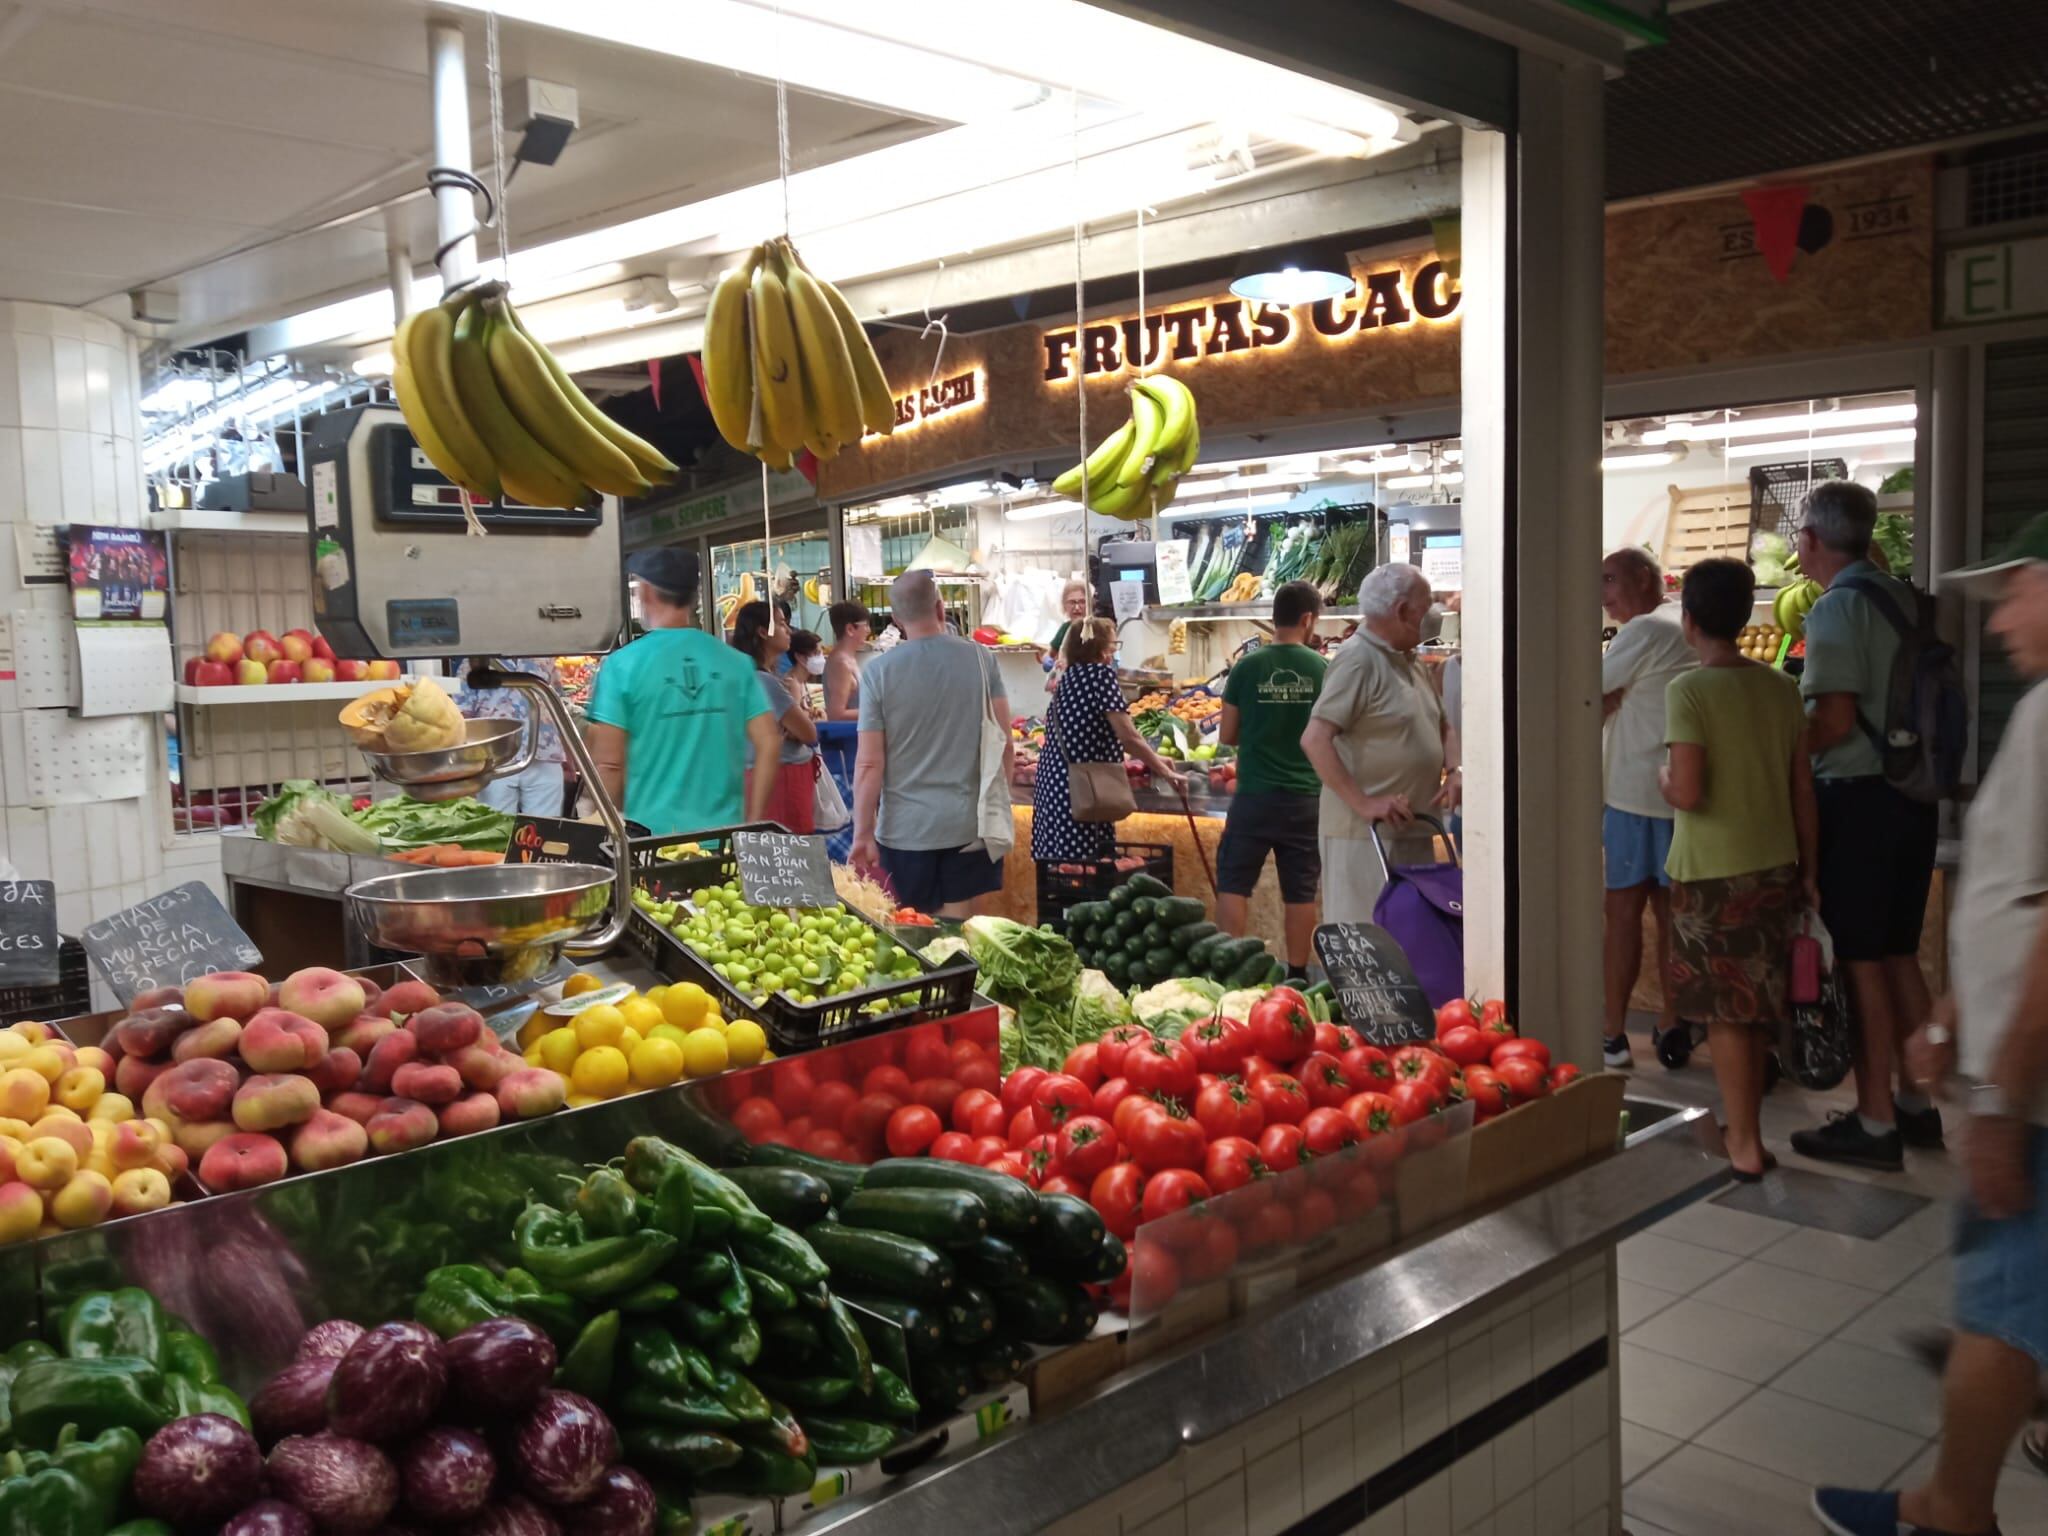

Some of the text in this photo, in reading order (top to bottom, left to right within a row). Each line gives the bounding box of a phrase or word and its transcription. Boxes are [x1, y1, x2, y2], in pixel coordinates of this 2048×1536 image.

[1850, 204, 1910, 232] 1934
[1044, 300, 1290, 382] FRUTAS
[919, 370, 976, 418] CACHI
[737, 831, 810, 847] PERITAS
[739, 851, 809, 871] SAN JUAN
[773, 846, 790, 857] DE
[743, 871, 804, 887] VILLENA
[778, 868, 795, 877] DE
[754, 886, 793, 906] 6,40
[139, 918, 169, 938] DE
[101, 922, 205, 971] MURCIA
[1317, 931, 1376, 954] PERA
[111, 933, 223, 984] ESPECIAL
[1324, 953, 1379, 968] EXTRA
[1350, 1004, 1399, 1019] SUPER
